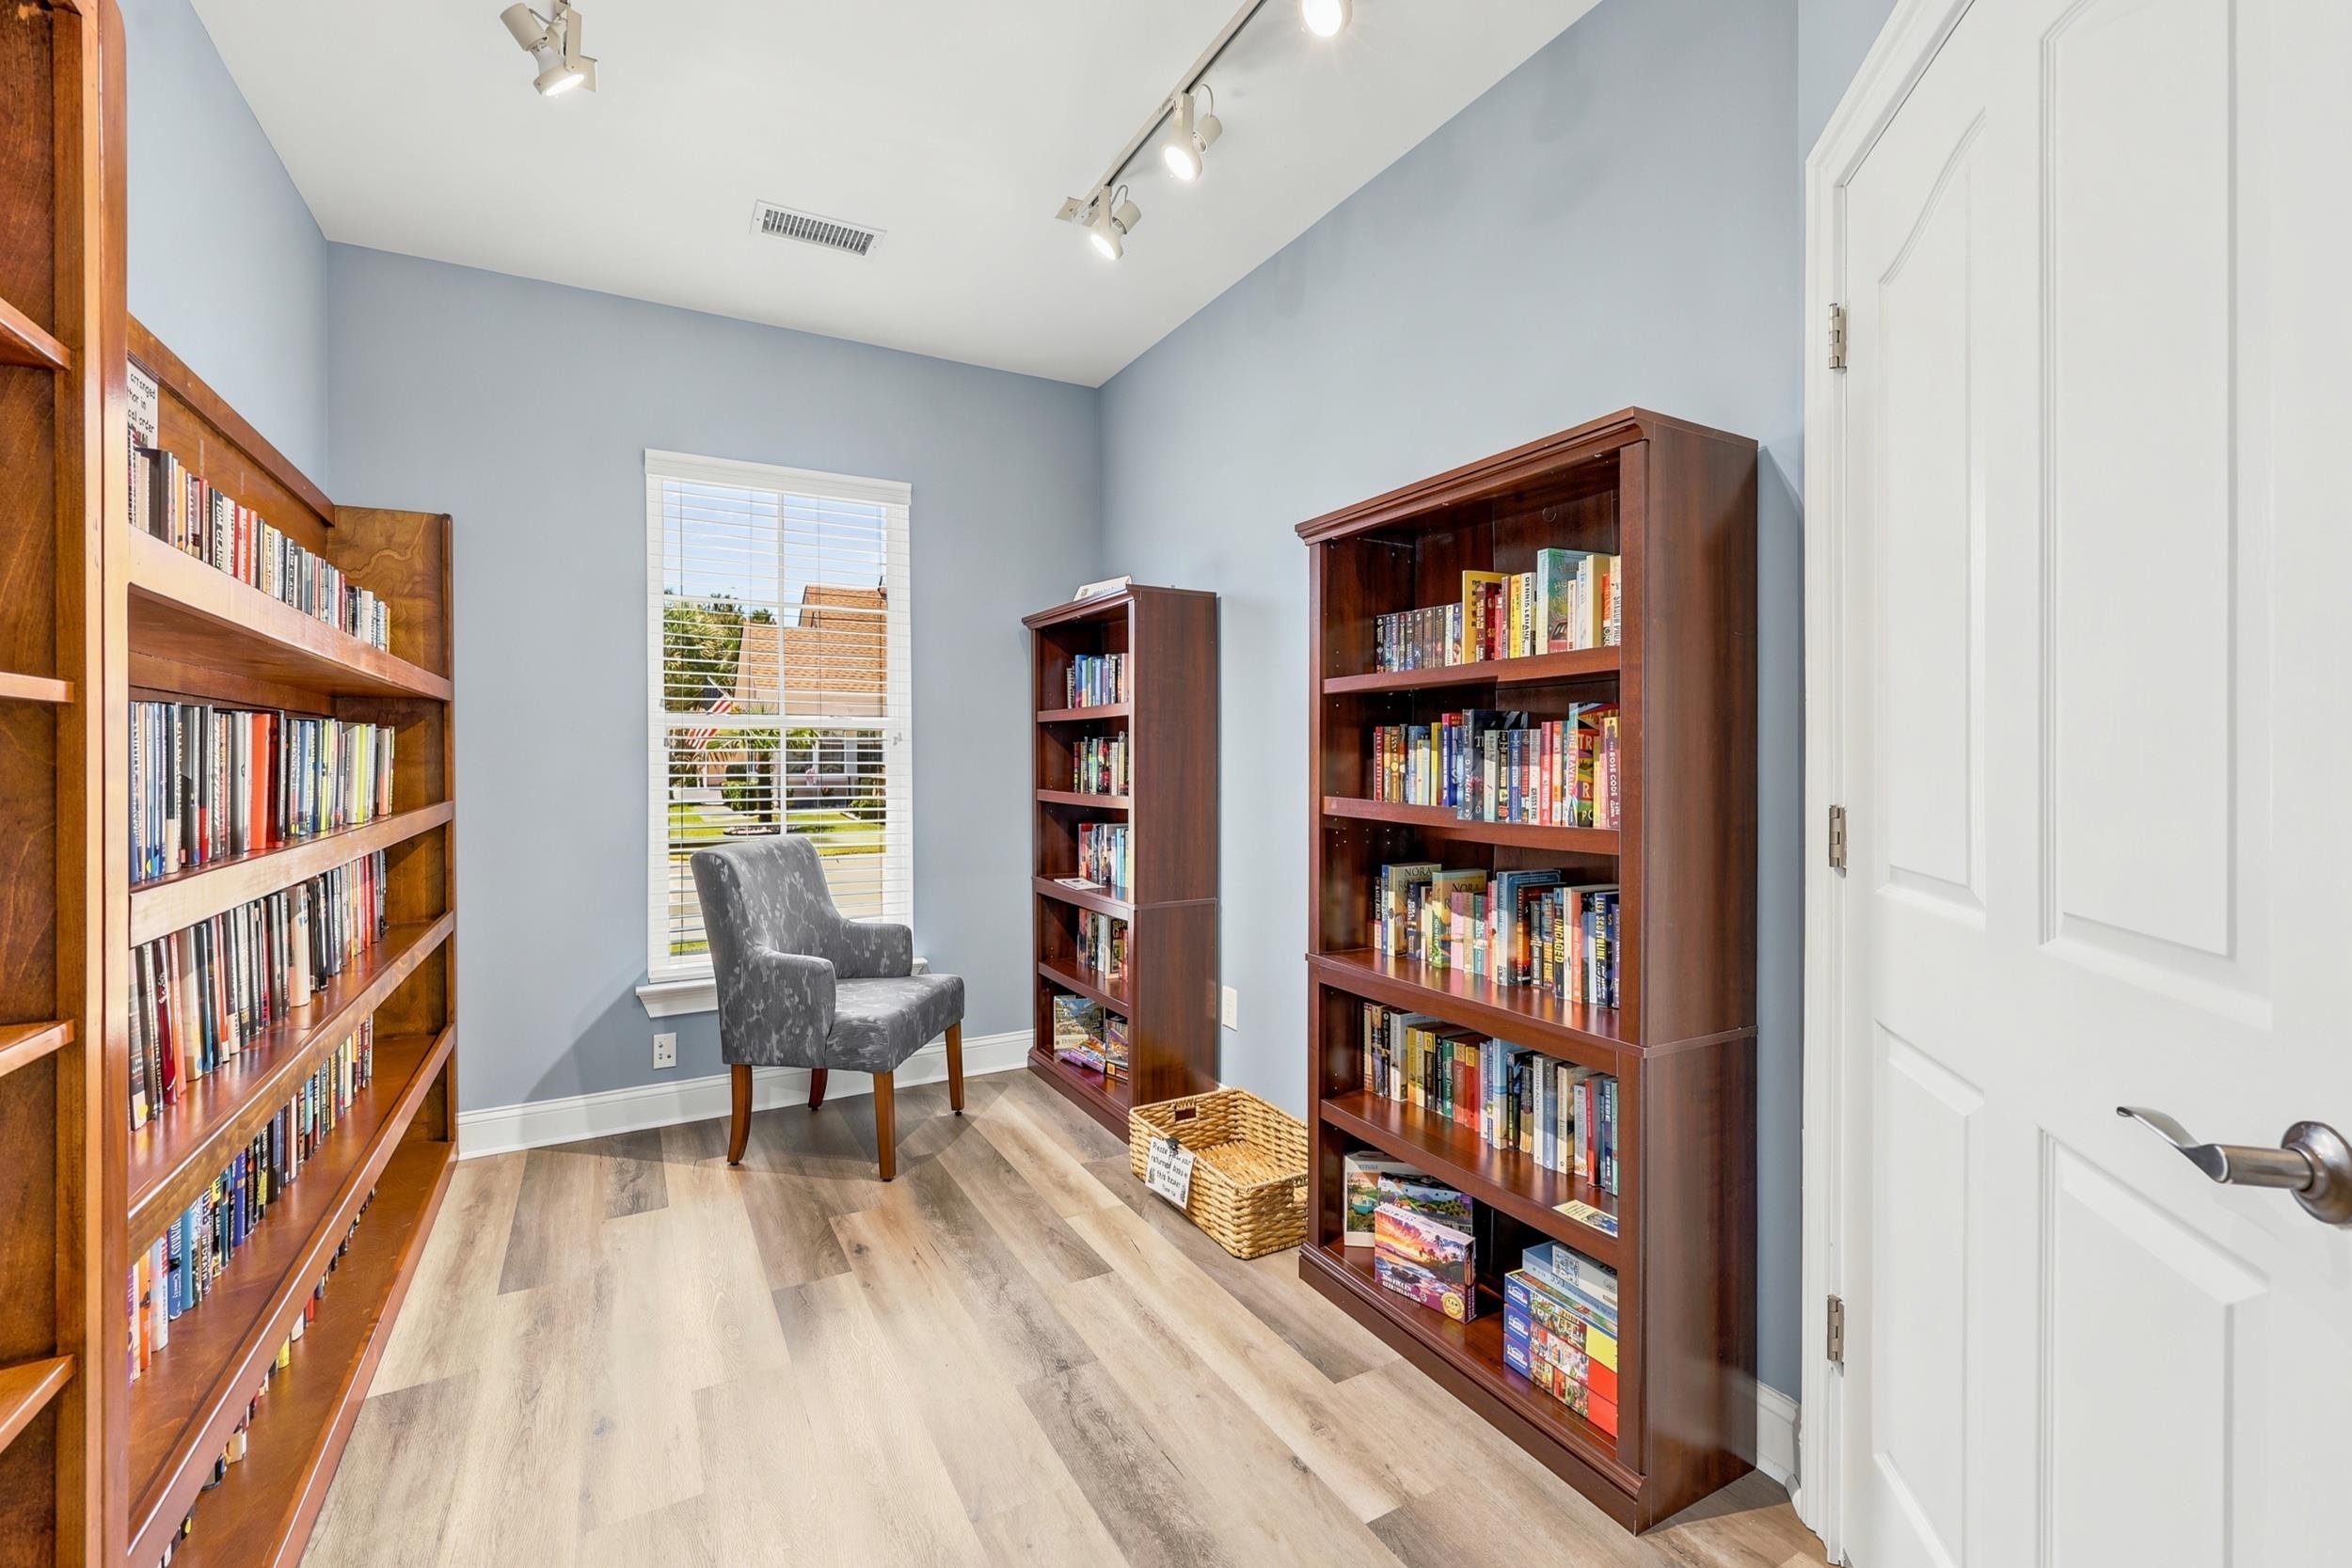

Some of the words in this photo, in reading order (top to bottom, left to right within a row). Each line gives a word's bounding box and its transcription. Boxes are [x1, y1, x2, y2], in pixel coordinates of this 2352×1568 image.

[215, 528, 224, 569] CLANC
[1404, 866, 1431, 877] NORA
[1596, 915, 1606, 960] SCOTTOLINE
